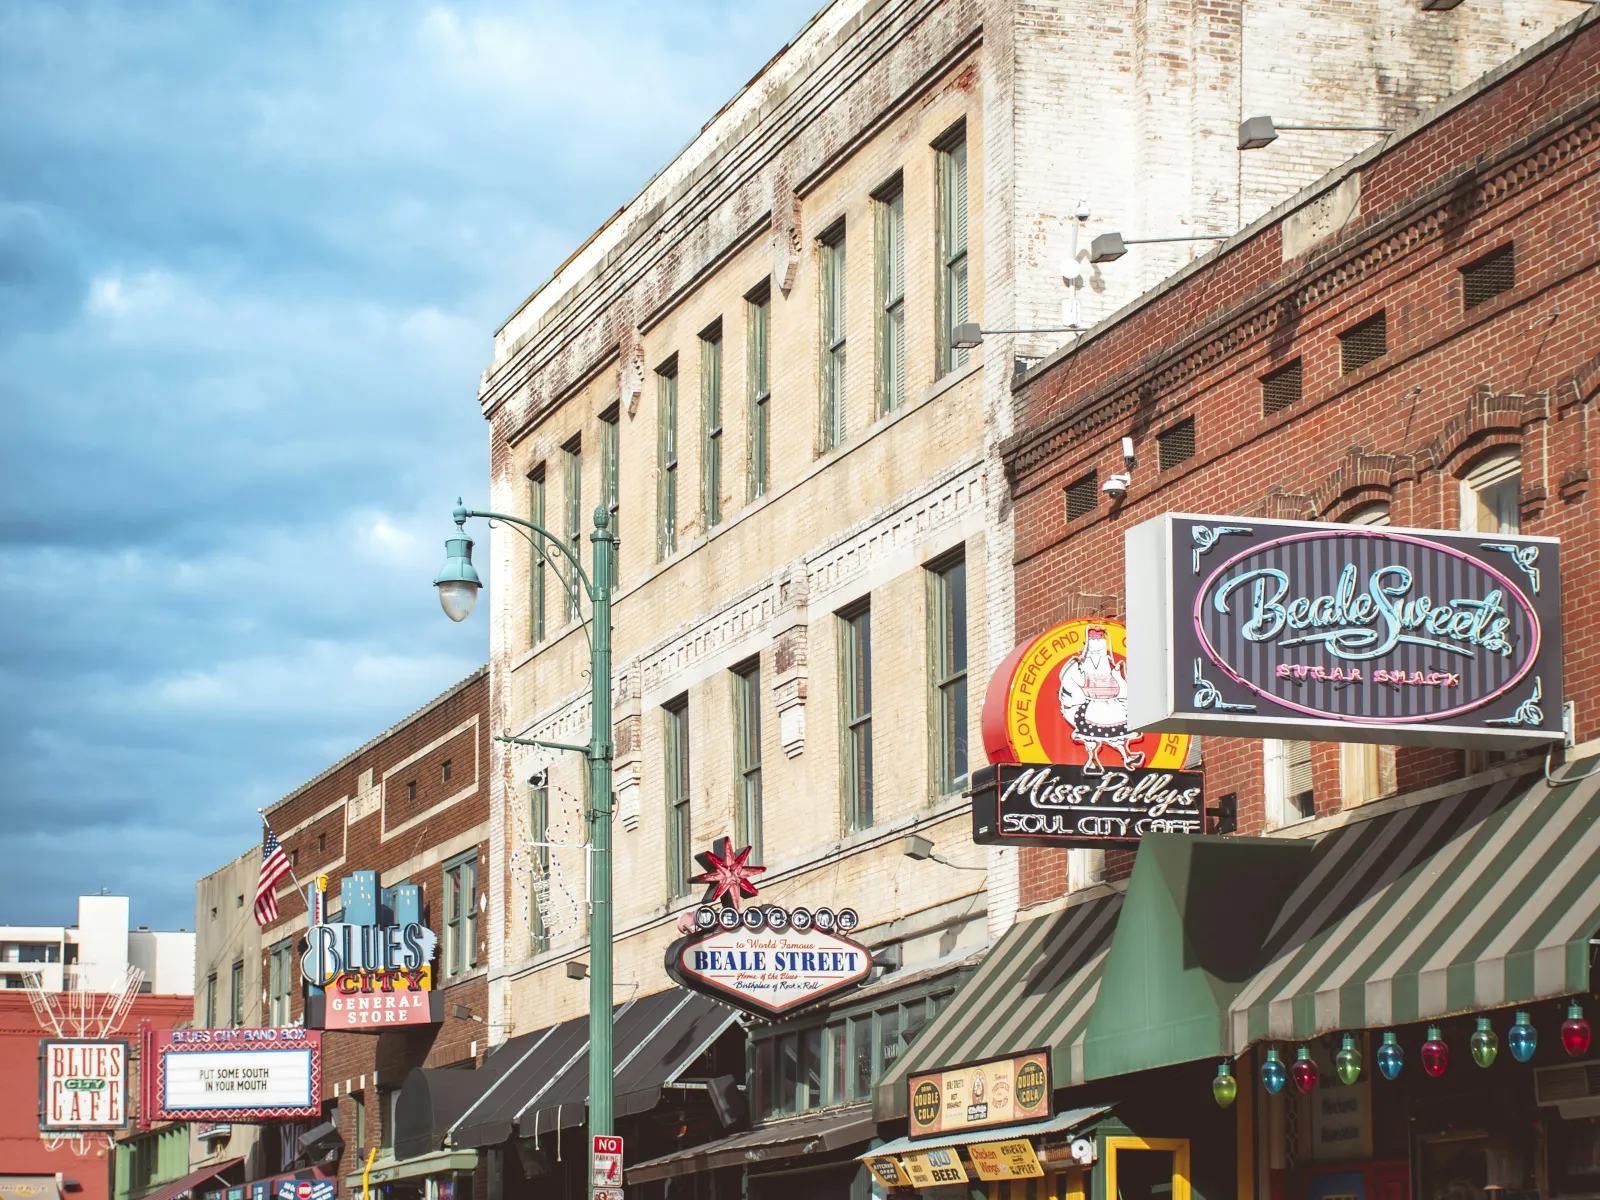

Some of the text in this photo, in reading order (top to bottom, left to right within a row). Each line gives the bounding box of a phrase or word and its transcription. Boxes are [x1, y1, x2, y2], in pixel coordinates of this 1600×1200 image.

[1215, 563, 1512, 661] Beale Sweets
[1020, 647, 1053, 695] PEACE
[1051, 630, 1079, 653] AND
[1276, 663, 1460, 687] SUGAR SHACK
[1001, 768, 1092, 806] Miss
[1003, 813, 1075, 834] SOUL
[1077, 816, 1131, 836] CITY
[697, 908, 858, 929] WELCOME
[736, 938, 815, 949] to World Famous
[302, 923, 423, 986] BLUES
[694, 951, 858, 971] BEALE STREET
[336, 971, 427, 994] CITY
[736, 972, 758, 980] Home
[760, 973, 766, 981] of
[779, 972, 798, 980] Blues
[734, 981, 771, 991] Birthplace
[772, 983, 778, 992] of
[779, 981, 796, 990] Rock
[332, 996, 422, 1010] GENERAL
[348, 1010, 408, 1024] STORE
[172, 1028, 307, 1043] BLUES CITY BAND BOX
[53, 1048, 120, 1077] BLUES
[200, 1068, 269, 1079] PUT SOME SOUTH
[1018, 1071, 1044, 1089] DOUBLE
[66, 1080, 103, 1088] CITY
[205, 1080, 267, 1091] IN YOUR MOUTH
[53, 1081, 119, 1121] CAFE
[915, 1091, 939, 1107] DOUBLE
[1021, 1088, 1039, 1103] COLA
[918, 1107, 935, 1121] COLA
[598, 1139, 617, 1151] NO
[927, 1150, 951, 1168] COLD
[972, 1147, 998, 1160] Chicken
[931, 1168, 961, 1182] BEER
[980, 1161, 1001, 1175] Wings
